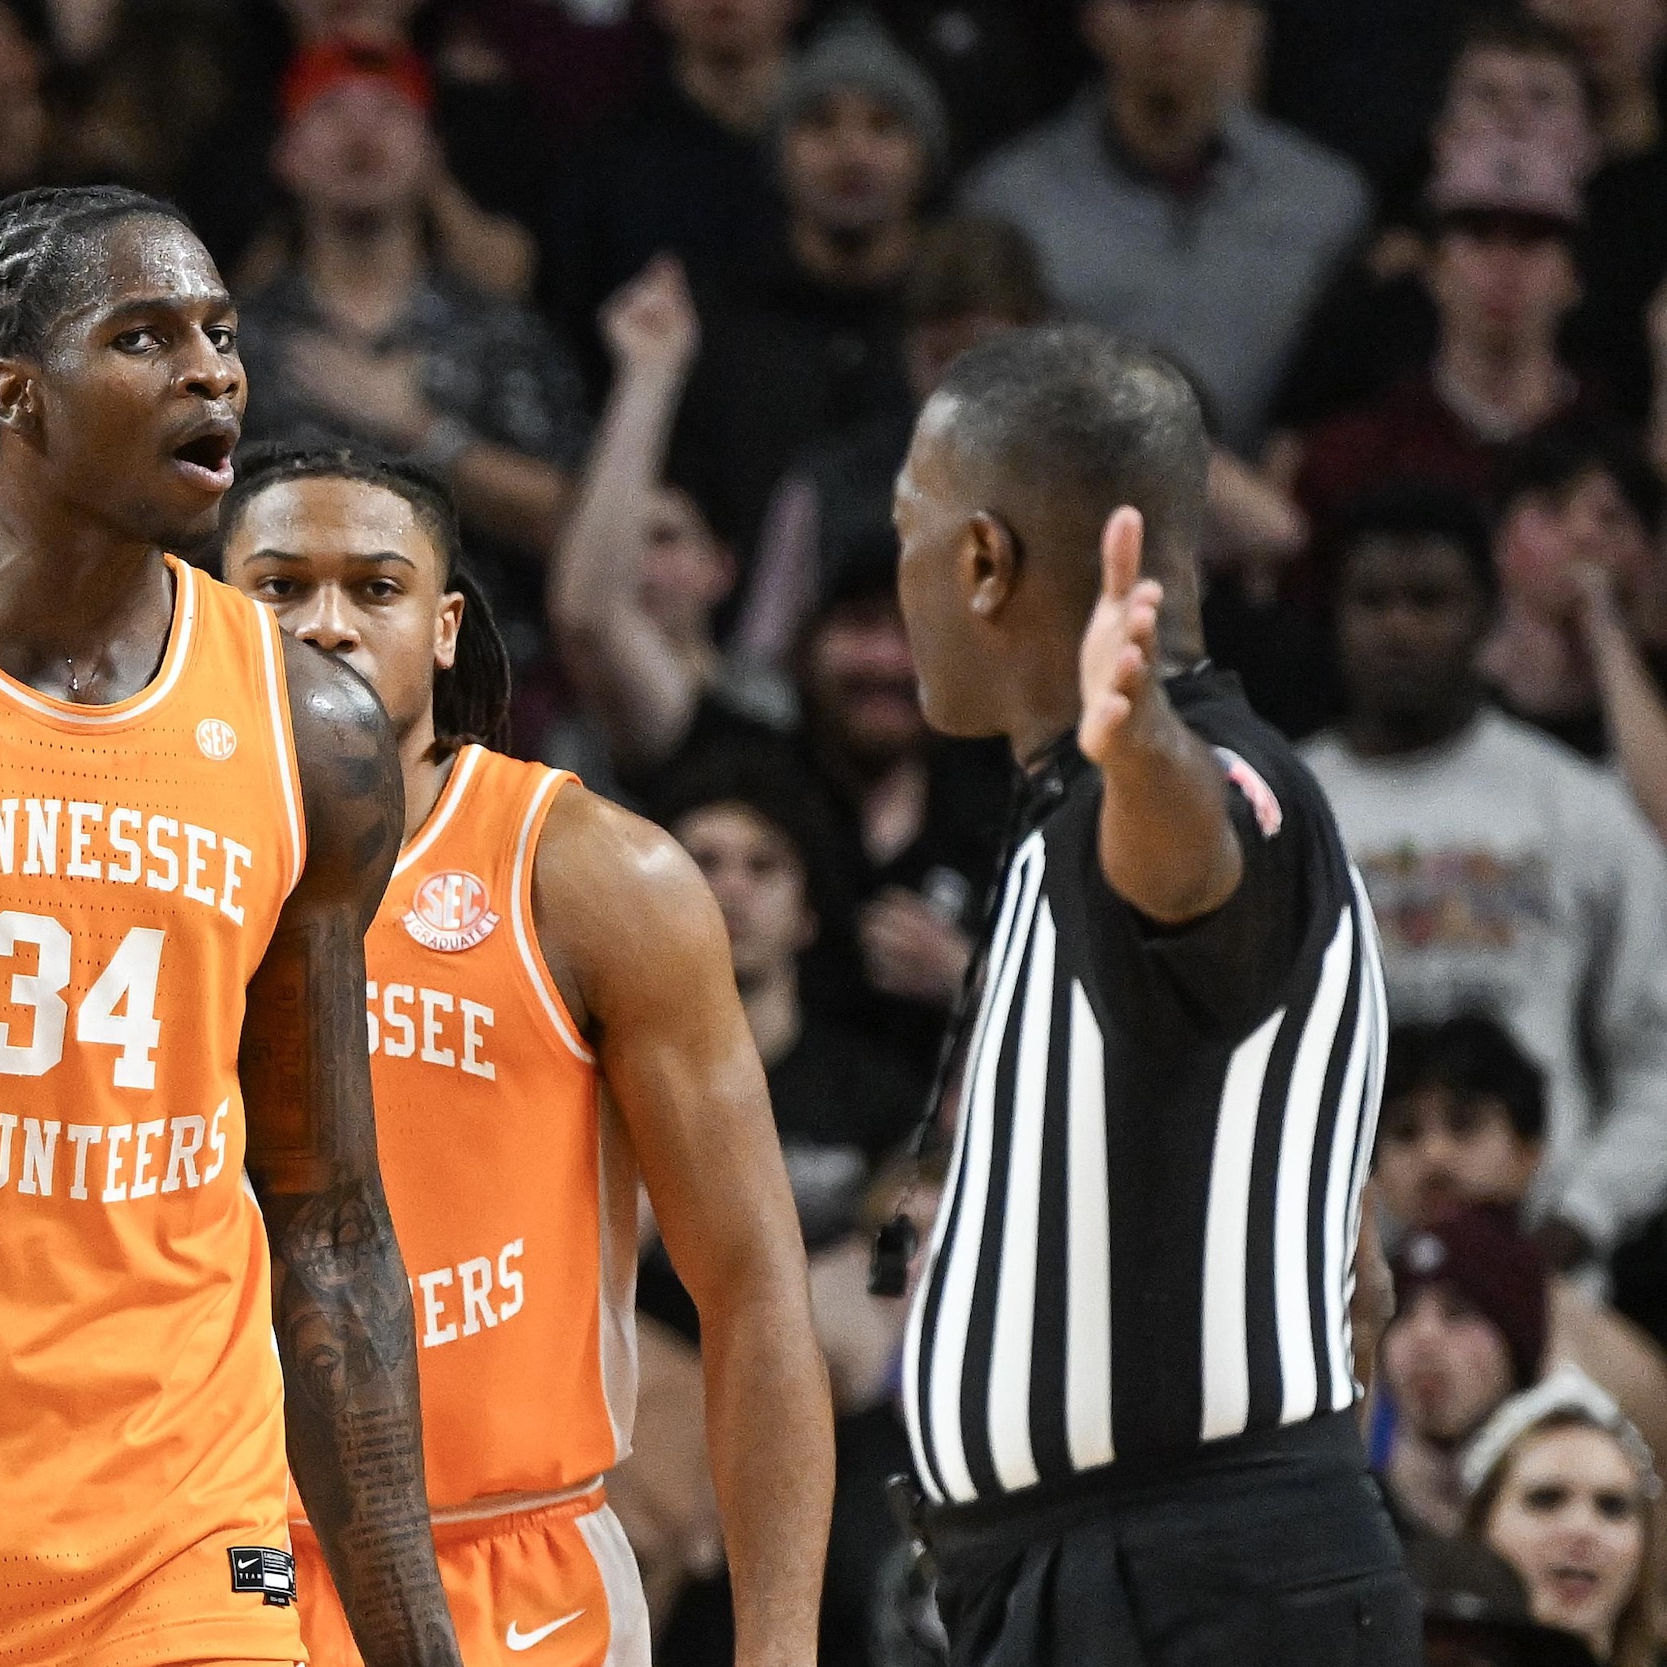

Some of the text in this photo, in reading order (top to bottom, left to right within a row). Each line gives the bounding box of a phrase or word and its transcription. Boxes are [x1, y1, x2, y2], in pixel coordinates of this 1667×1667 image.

[198, 720, 235, 757] SEC
[421, 875, 483, 929] SEC
[410, 923, 489, 950] GRADUATE
[409, 1238, 524, 1349] ERS
